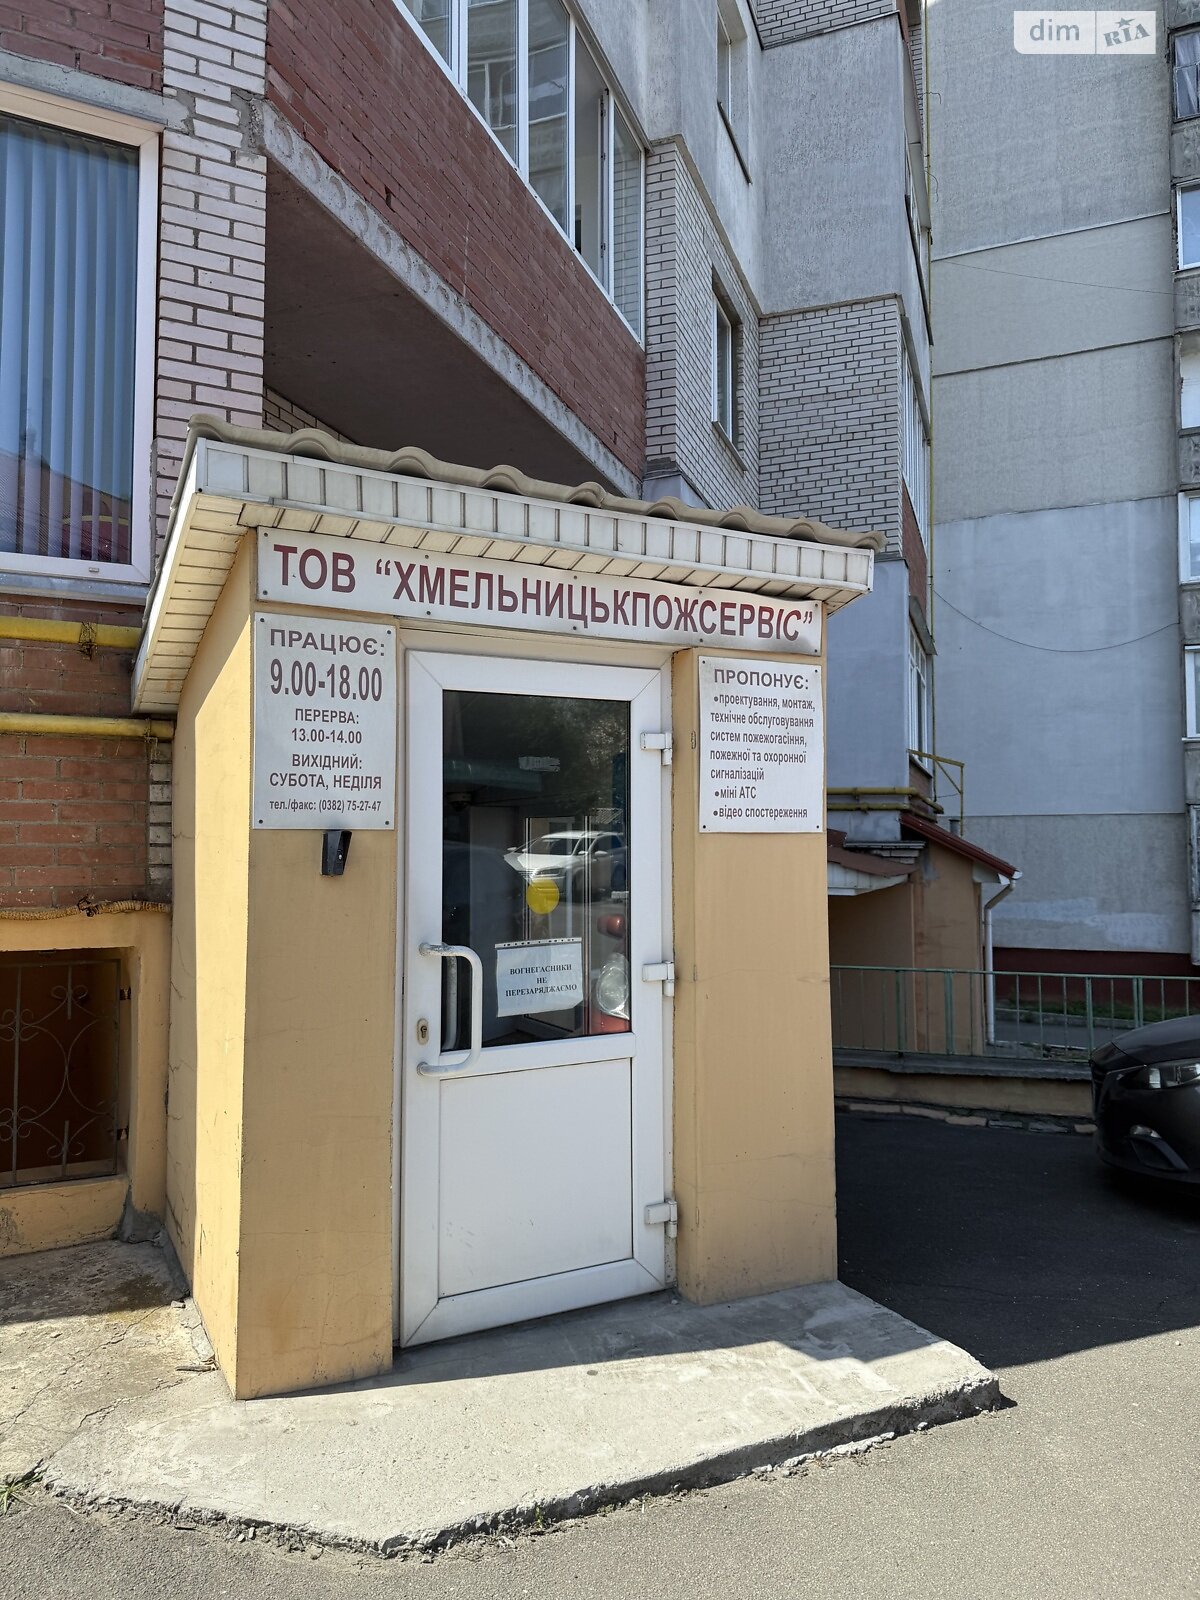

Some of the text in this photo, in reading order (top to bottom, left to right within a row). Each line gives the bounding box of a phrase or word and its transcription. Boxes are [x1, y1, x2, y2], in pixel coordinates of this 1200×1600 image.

[274, 544, 813, 641] ТОВ “ХМЕЛЬНИЦЬКПОЖСЕРВІС”
[270, 628, 385, 656] ПРАЦЮЄ:
[270, 658, 383, 701] 9.00-18.00
[714, 668, 809, 690] ПРОПОНУЄ:
[782, 698, 816, 712] монтаж,
[295, 708, 360, 724] ПЕРЕРВА:
[710, 710, 814, 729] технічне обслуговування
[291, 728, 362, 744] 13.00-14.00
[710, 730, 807, 747] систем пожежогасіння,
[292, 753, 363, 770] ВИХІДНИЙ:
[710, 748, 807, 766] пожежної та охоронної
[269, 772, 382, 791] СУБОТА, НЕДІЛЯ
[710, 767, 765, 781] сигналізацій
[739, 786, 757, 799] АТС
[269, 799, 382, 813] тел./факс: (0382) 75-27-47
[745, 806, 808, 821] спостереження
[509, 963, 572, 975] ВОГНЕГАСНИКИ
[536, 976, 548, 984] НЕ
